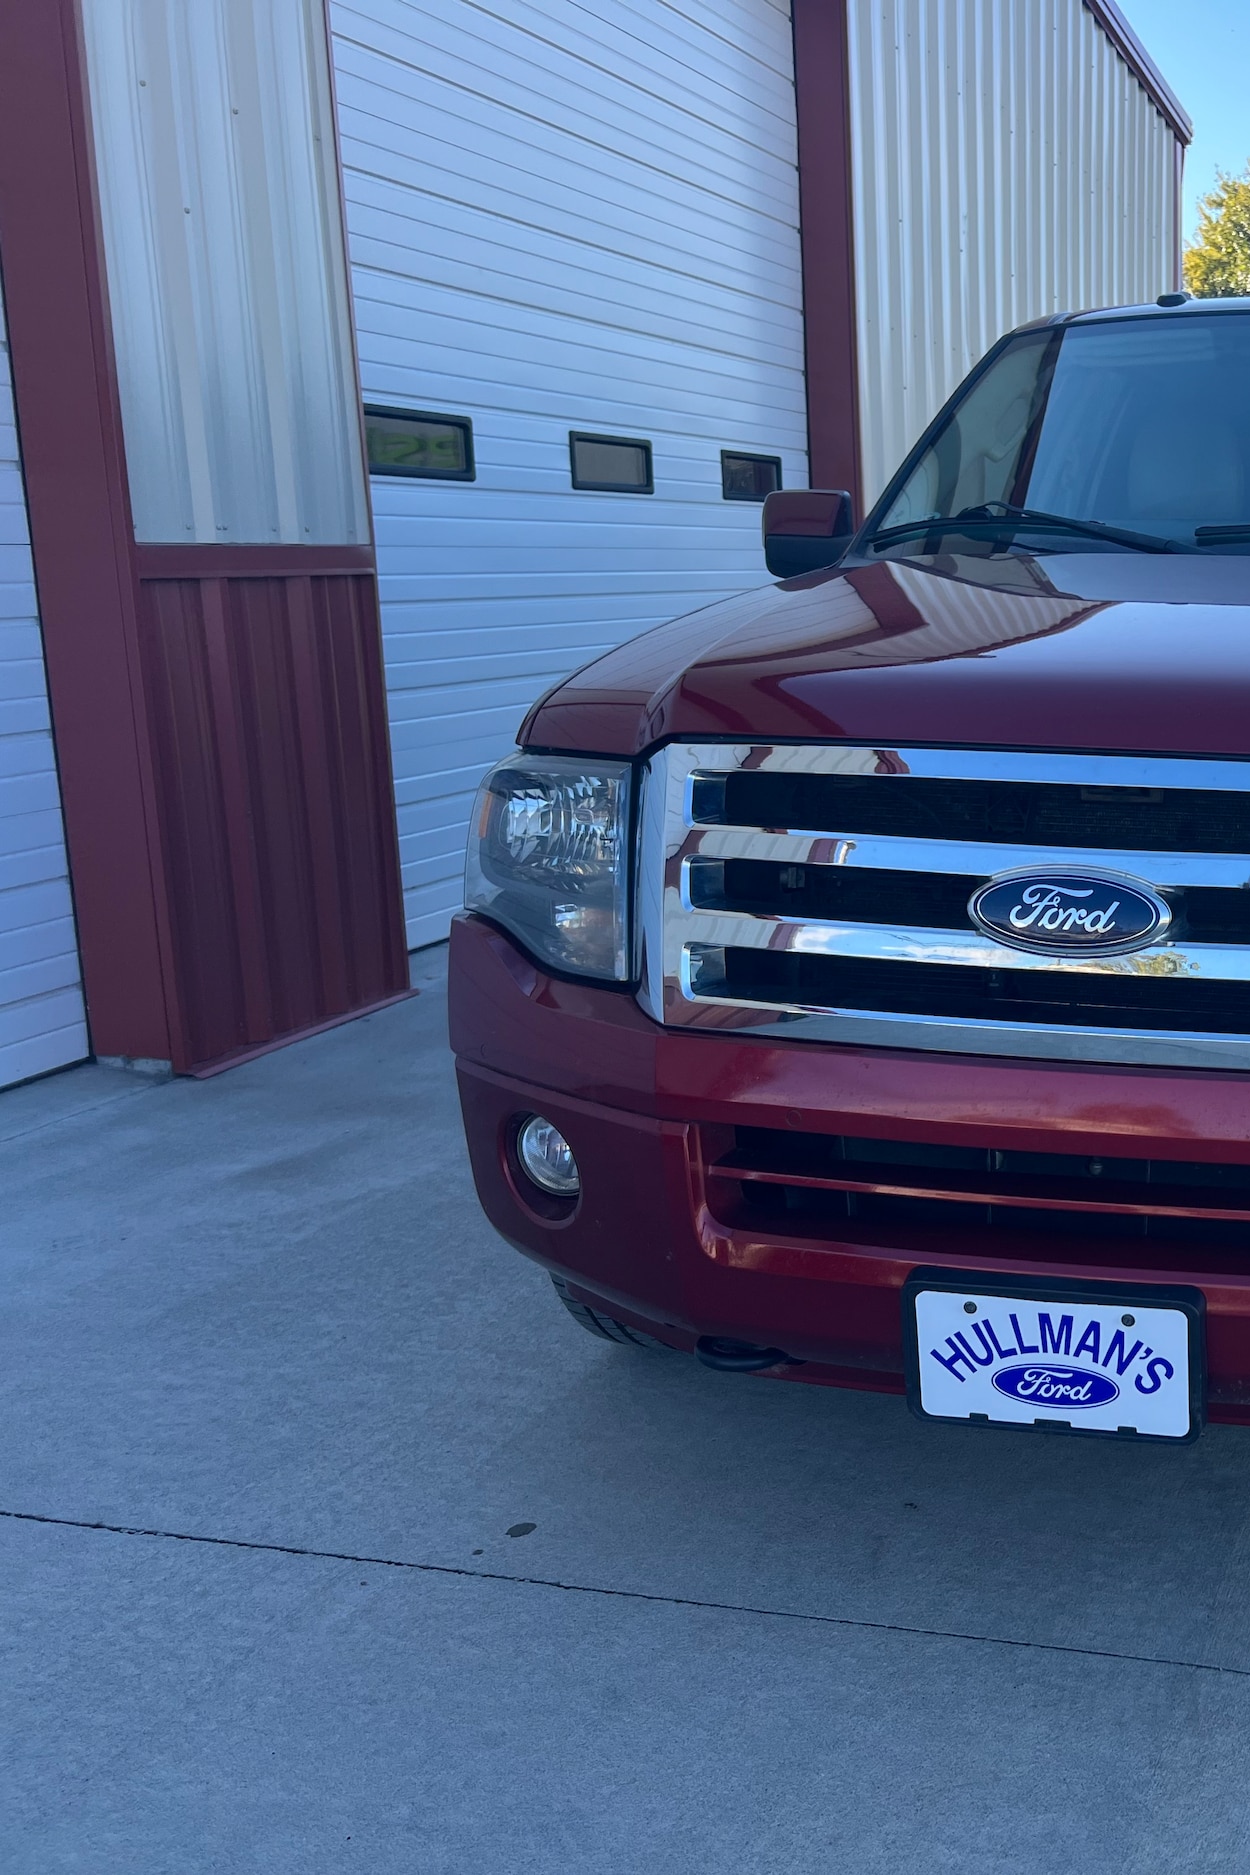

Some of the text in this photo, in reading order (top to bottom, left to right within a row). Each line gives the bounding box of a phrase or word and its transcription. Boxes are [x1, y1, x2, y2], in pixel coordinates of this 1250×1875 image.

[1009, 884, 1121, 933] Ford
[929, 1312, 1174, 1395] HULLMAN'S
[1017, 1368, 1091, 1401] Ford
